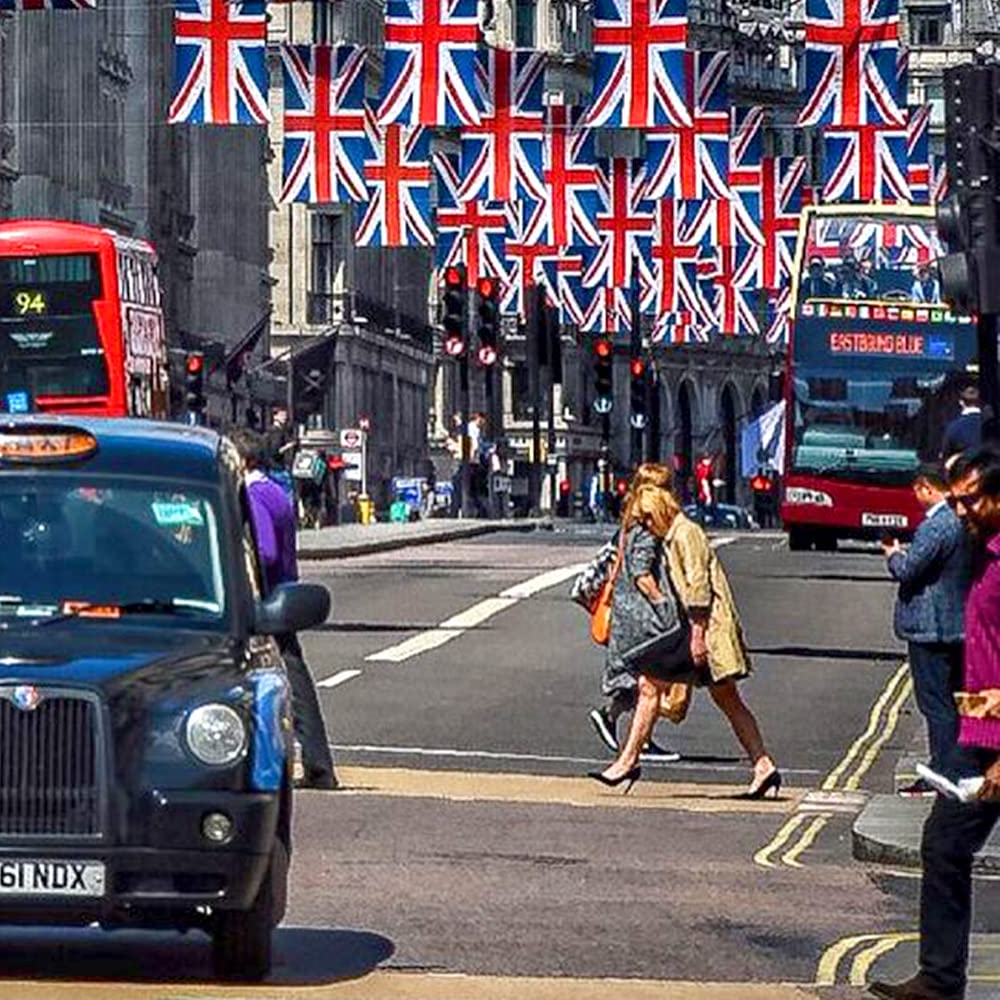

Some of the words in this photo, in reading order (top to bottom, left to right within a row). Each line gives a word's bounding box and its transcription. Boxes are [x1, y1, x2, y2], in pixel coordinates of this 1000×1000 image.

[15, 292, 45, 314] 94
[895, 334, 924, 354] BLUE
[33, 862, 87, 890] NDX
